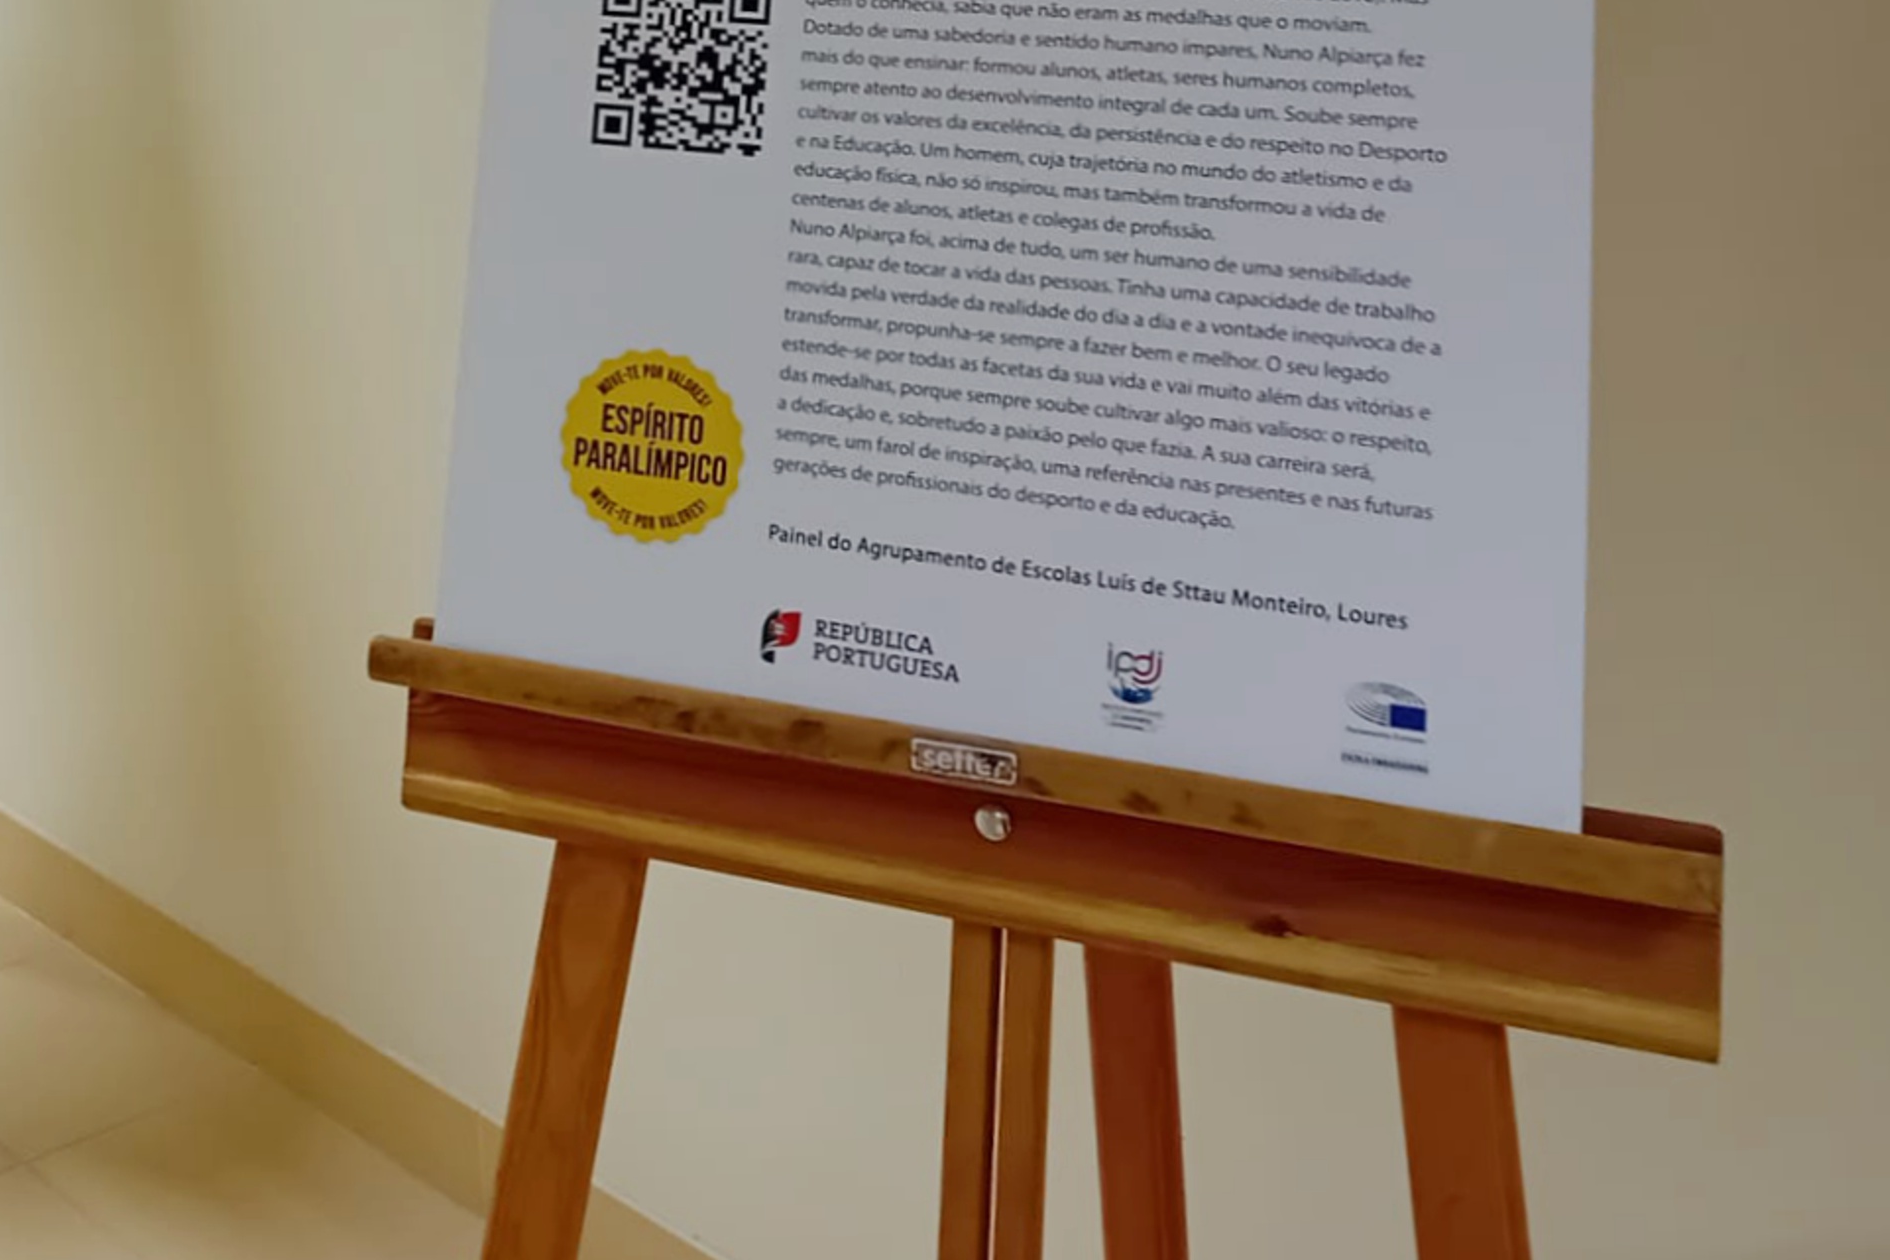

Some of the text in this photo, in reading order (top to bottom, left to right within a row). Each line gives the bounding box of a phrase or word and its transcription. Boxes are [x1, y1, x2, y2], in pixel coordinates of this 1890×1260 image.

[800, 50, 839, 65] mais
[841, 49, 866, 66] do
[867, 54, 901, 70] que
[972, 56, 1037, 77] formou
[1040, 61, 1102, 82] alunos,
[1105, 65, 1169, 86] atletas,
[1172, 71, 1218, 88] seres
[1222, 70, 1309, 93] humanos
[799, 78, 1419, 132] sempre atento ao desenvolvimento integral de cada um. Soube sempre
[789, 218, 1412, 289] Nuno Alpiarça foi, acima de tudo, um ser humano de uma sensibilidade
[596, 363, 713, 408] MOVE-TE POR VALORES!
[601, 401, 704, 445] ESPÍRITO
[778, 364, 809, 384] das
[811, 371, 897, 397] medalhas,
[899, 382, 963, 403] porque
[966, 389, 1032, 412] sempre
[1034, 396, 1091, 417] soube
[1092, 402, 1161, 424] cultivar
[1163, 408, 1206, 433] algo
[1208, 416, 1253, 435] mais
[1330, 430, 1346, 445] o
[1348, 432, 1433, 457] respeito,
[573, 438, 727, 487] PARALÍMPICO
[589, 486, 708, 530] MOVE-TE POR VALORES!
[772, 457, 1235, 531] gerações de profissionais do desporto e da educação.
[767, 522, 1409, 631] Painel do Agrupamento de Escolas Luís de Sttau Monteiro, Loures
[813, 618, 934, 657] REPÚBLICA
[812, 641, 960, 684] PORTUGUESA
